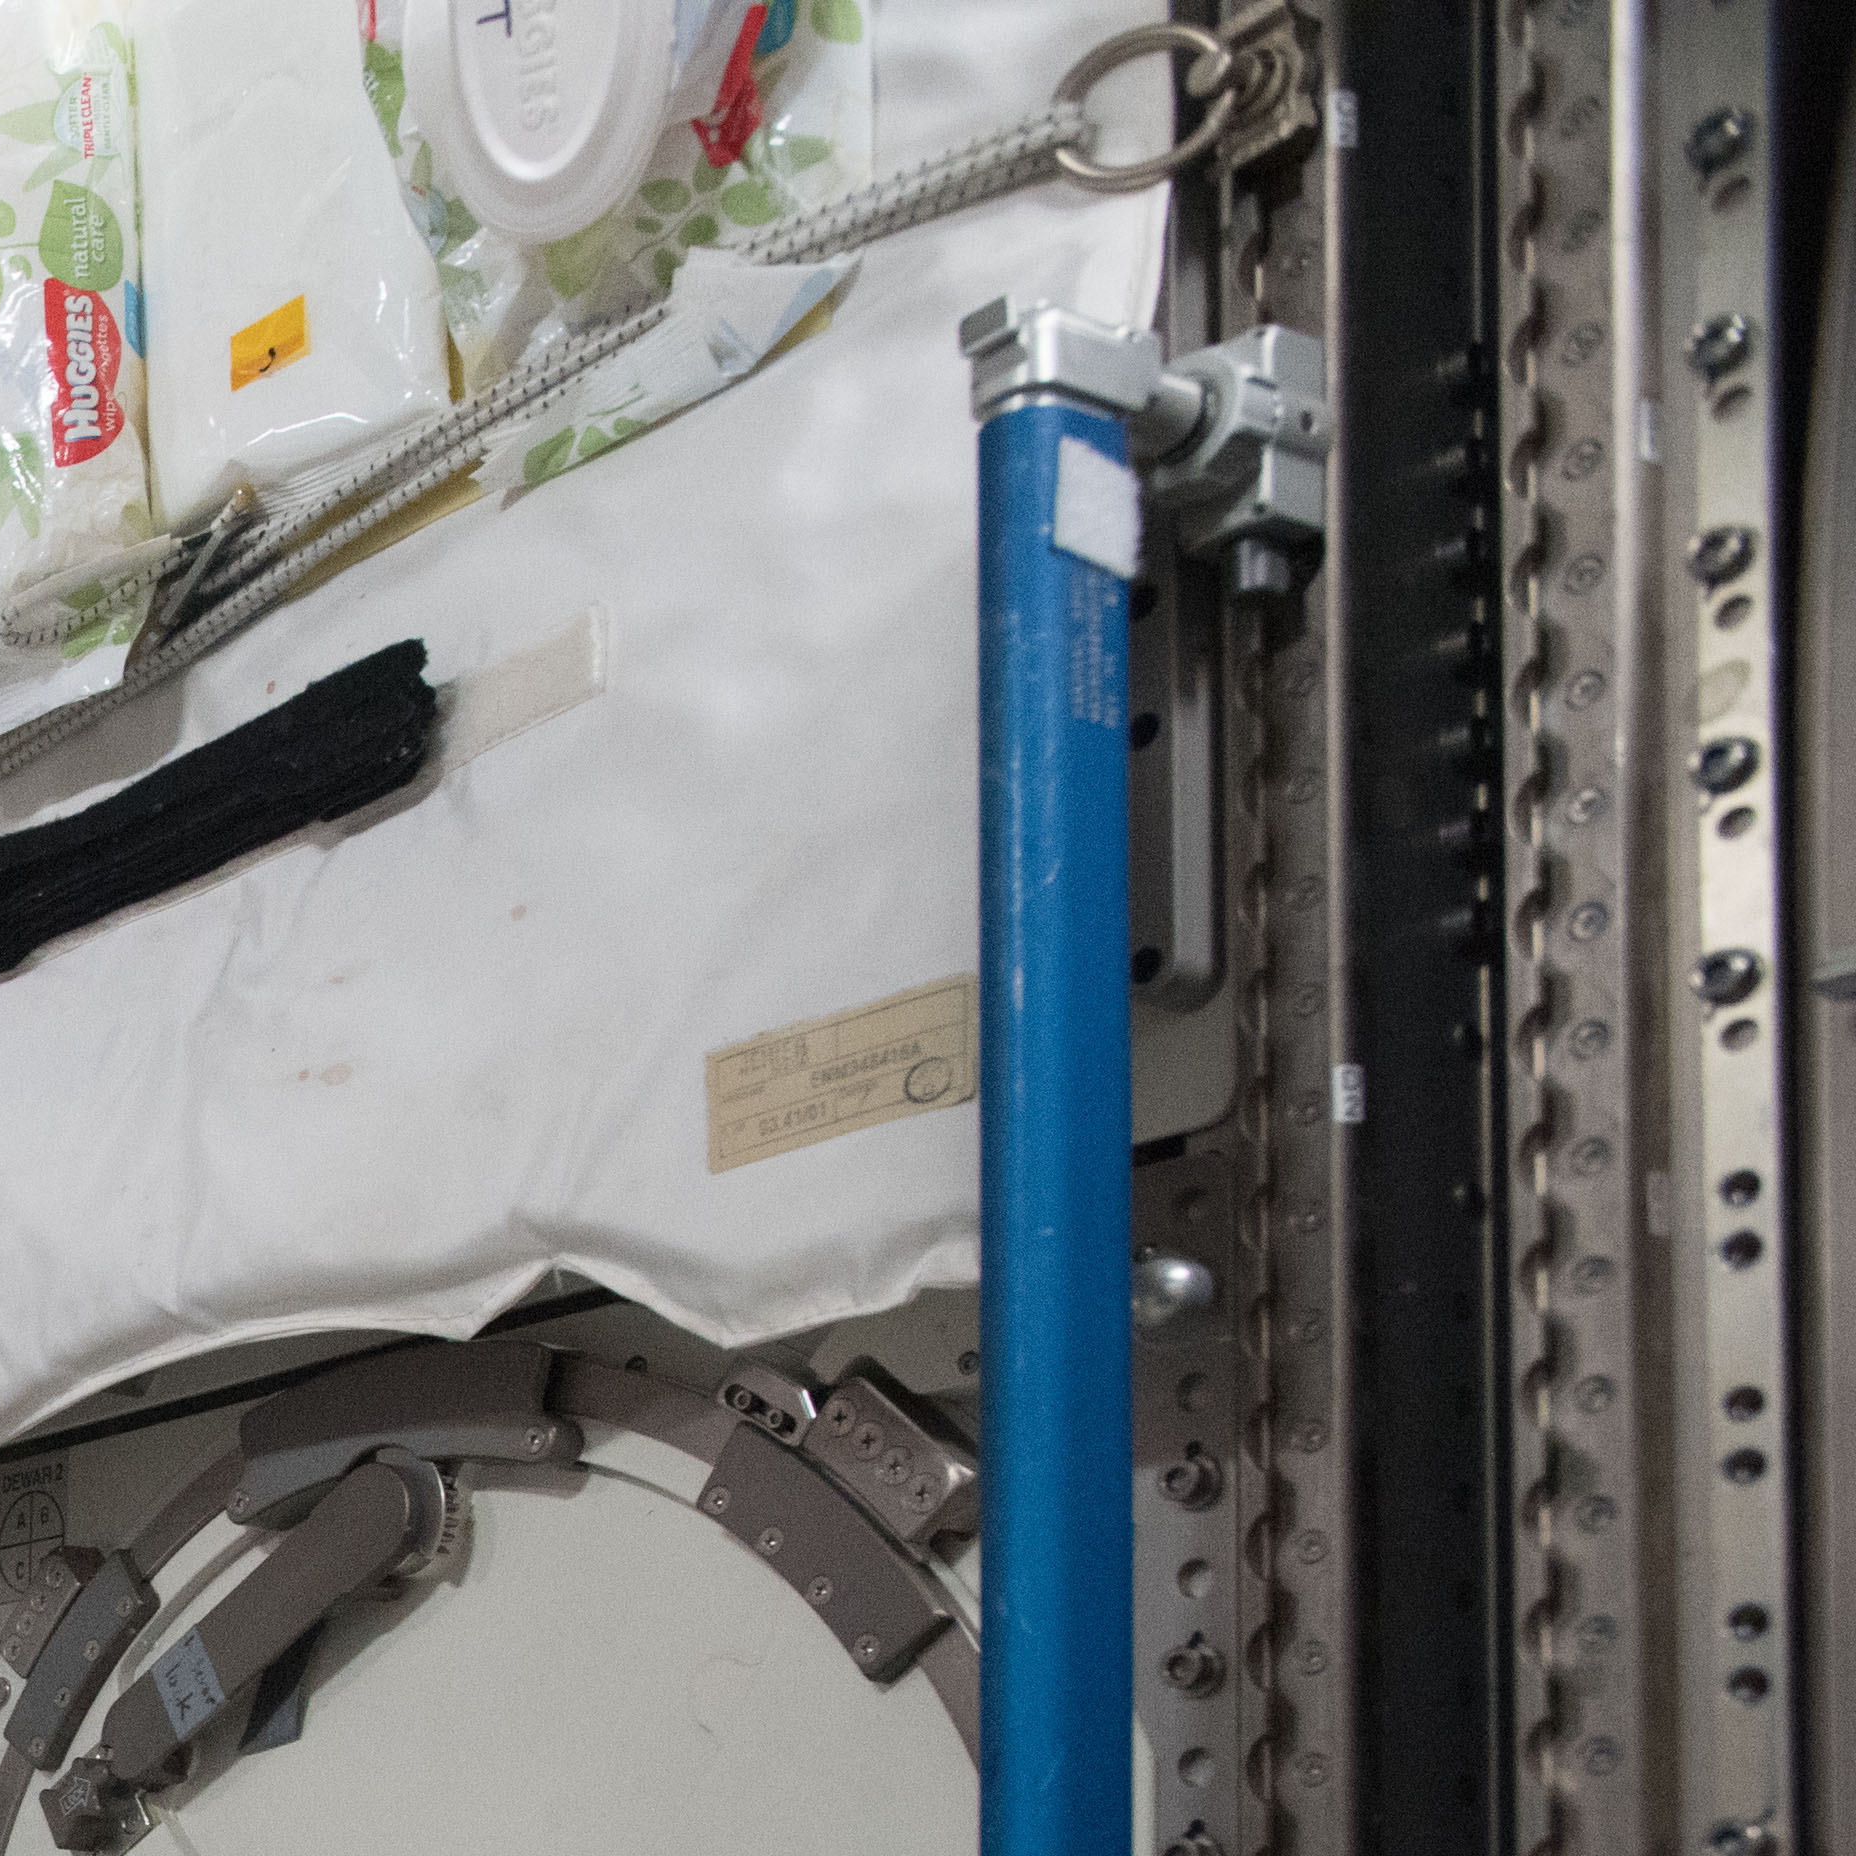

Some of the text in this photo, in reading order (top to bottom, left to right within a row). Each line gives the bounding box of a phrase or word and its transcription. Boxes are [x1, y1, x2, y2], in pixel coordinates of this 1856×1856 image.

[80, 76, 95, 160] TRIPLE CLEAN
[63, 198, 89, 280] natural
[92, 214, 106, 263] care
[62, 294, 102, 443] HUGGIES
[2, 1462, 64, 1494] DEWAR 2
[16, 1506, 50, 1529] A B
[15, 1561, 25, 1581] C
